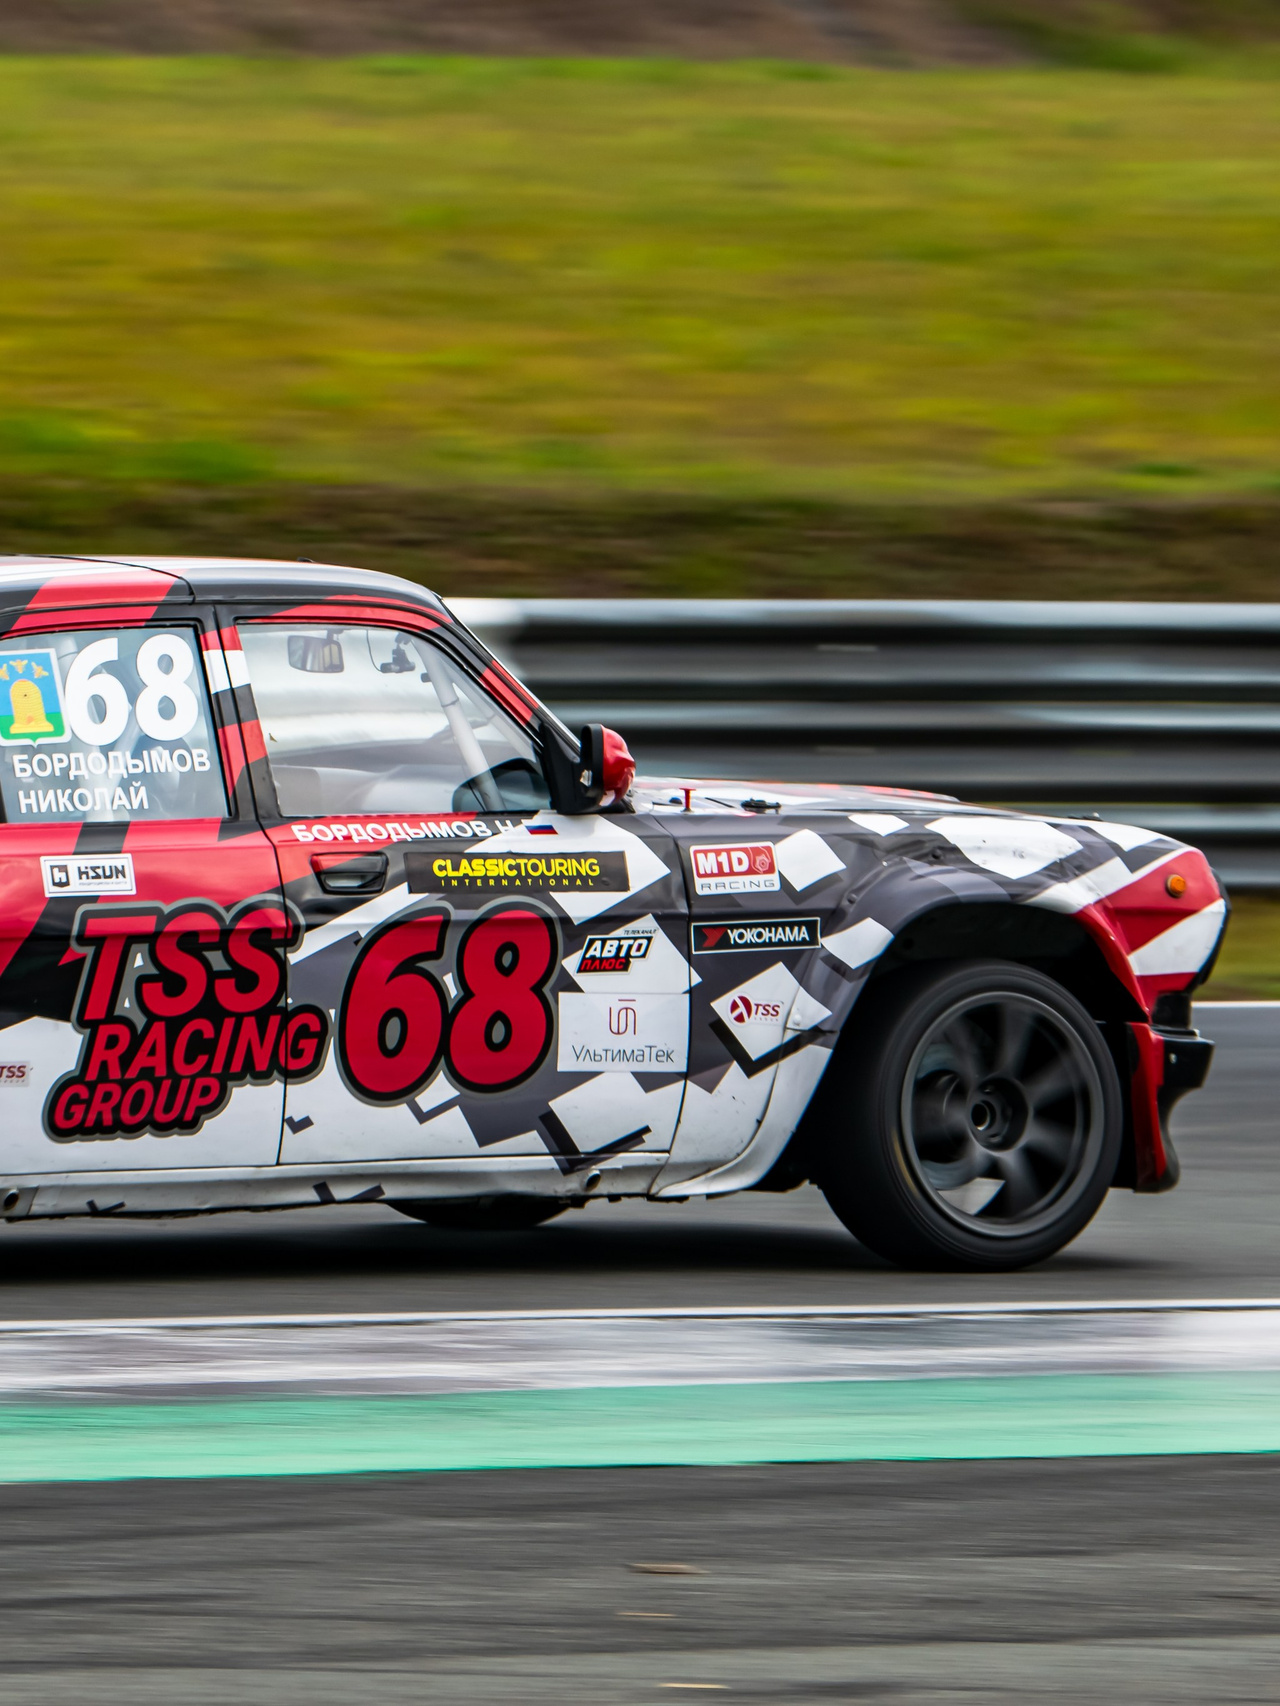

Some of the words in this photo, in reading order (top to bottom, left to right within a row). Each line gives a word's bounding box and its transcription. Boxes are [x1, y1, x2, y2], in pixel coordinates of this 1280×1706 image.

[64, 633, 199, 746] 68
[12, 749, 211, 780] БОРДОДЫМОВ
[18, 781, 149, 814] НИКОЛАЙ
[291, 820, 493, 843] БОРДОДЫМОВ
[432, 858, 600, 878] CLASSICTOURING
[696, 850, 750, 875] M1D
[441, 878, 595, 888] INTERNATIONAL
[700, 879, 775, 891] RACING
[726, 925, 810, 946] YOKOHAMA
[585, 938, 650, 958] АВТО
[83, 908, 294, 1021] TSS
[580, 958, 626, 971] ПЛЮС
[345, 909, 552, 1094] 68
[754, 1003, 781, 1017] TSS
[84, 1012, 322, 1082] RACING
[571, 1044, 675, 1064] УльтимаТек
[53, 1077, 221, 1130] GROUP
